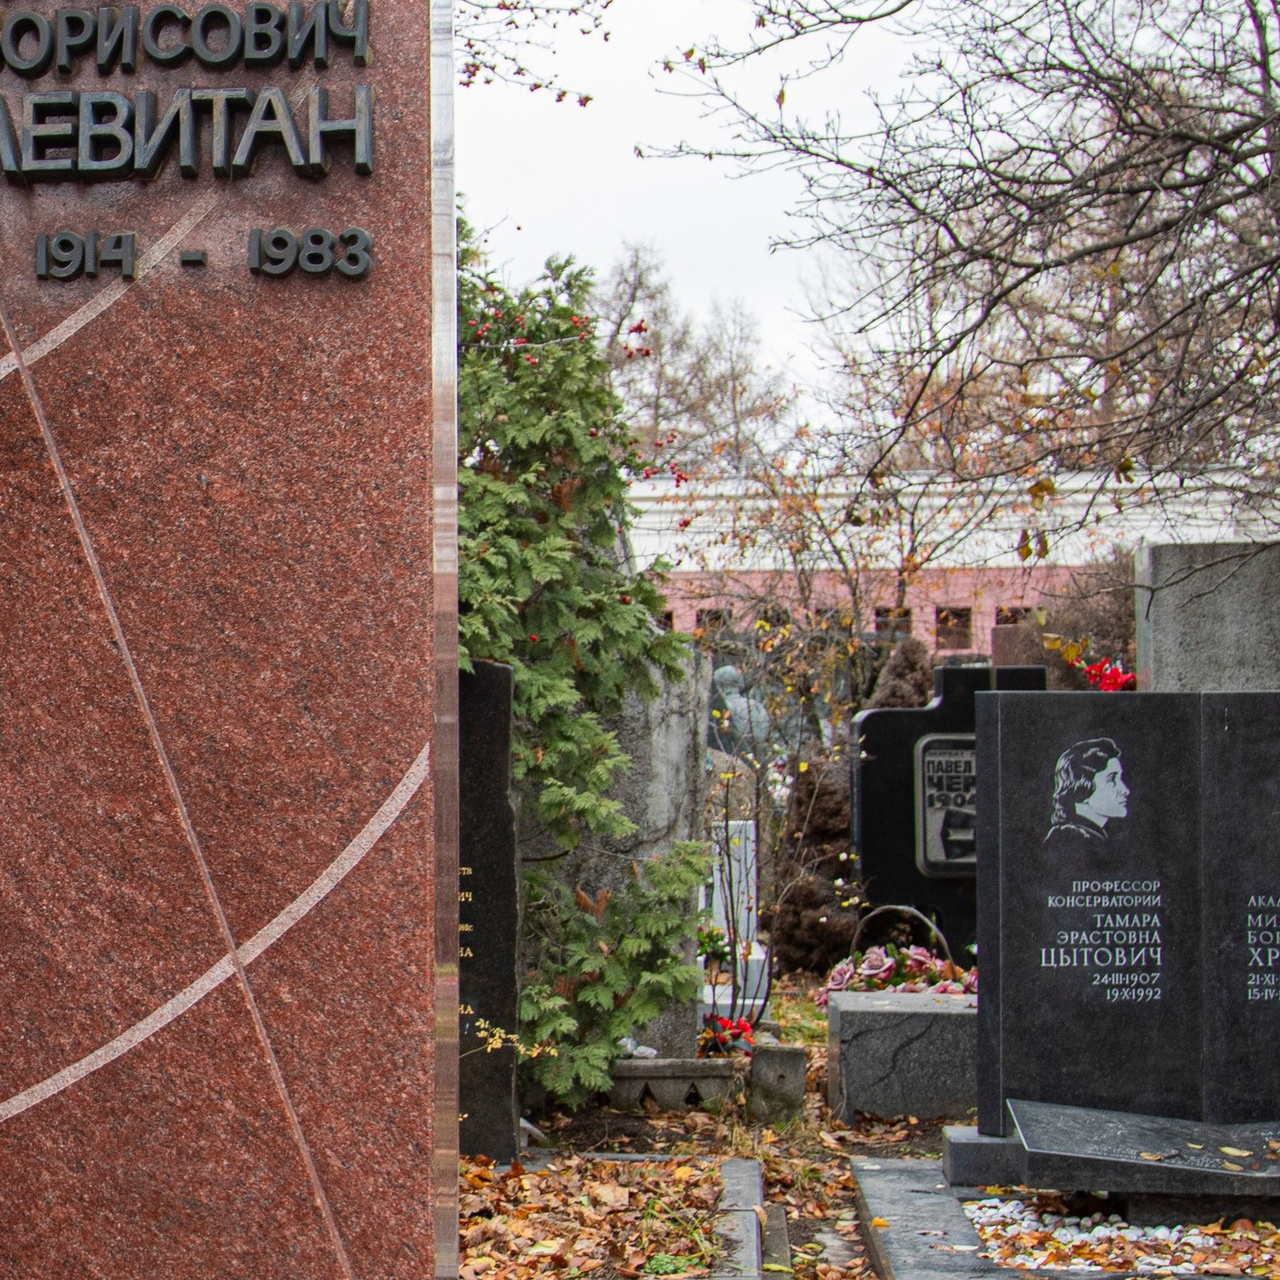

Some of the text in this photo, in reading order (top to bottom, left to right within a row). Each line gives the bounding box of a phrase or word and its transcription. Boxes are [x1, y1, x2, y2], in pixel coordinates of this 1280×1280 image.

[36, 230, 138, 281] 1914
[249, 226, 373, 280] 1983
[927, 760, 972, 774] ПАВЕЛ
[1072, 880, 1160, 893] ПРОФЕССОР
[1047, 895, 1161, 908] КОНСЕРВАТОРИИ
[1093, 913, 1161, 928] ТАМАРА
[1247, 913, 1280, 928] МИ
[1056, 930, 1161, 945] ЭРАСТОВНА
[1040, 947, 1162, 968] ЦЫТОВИЧ
